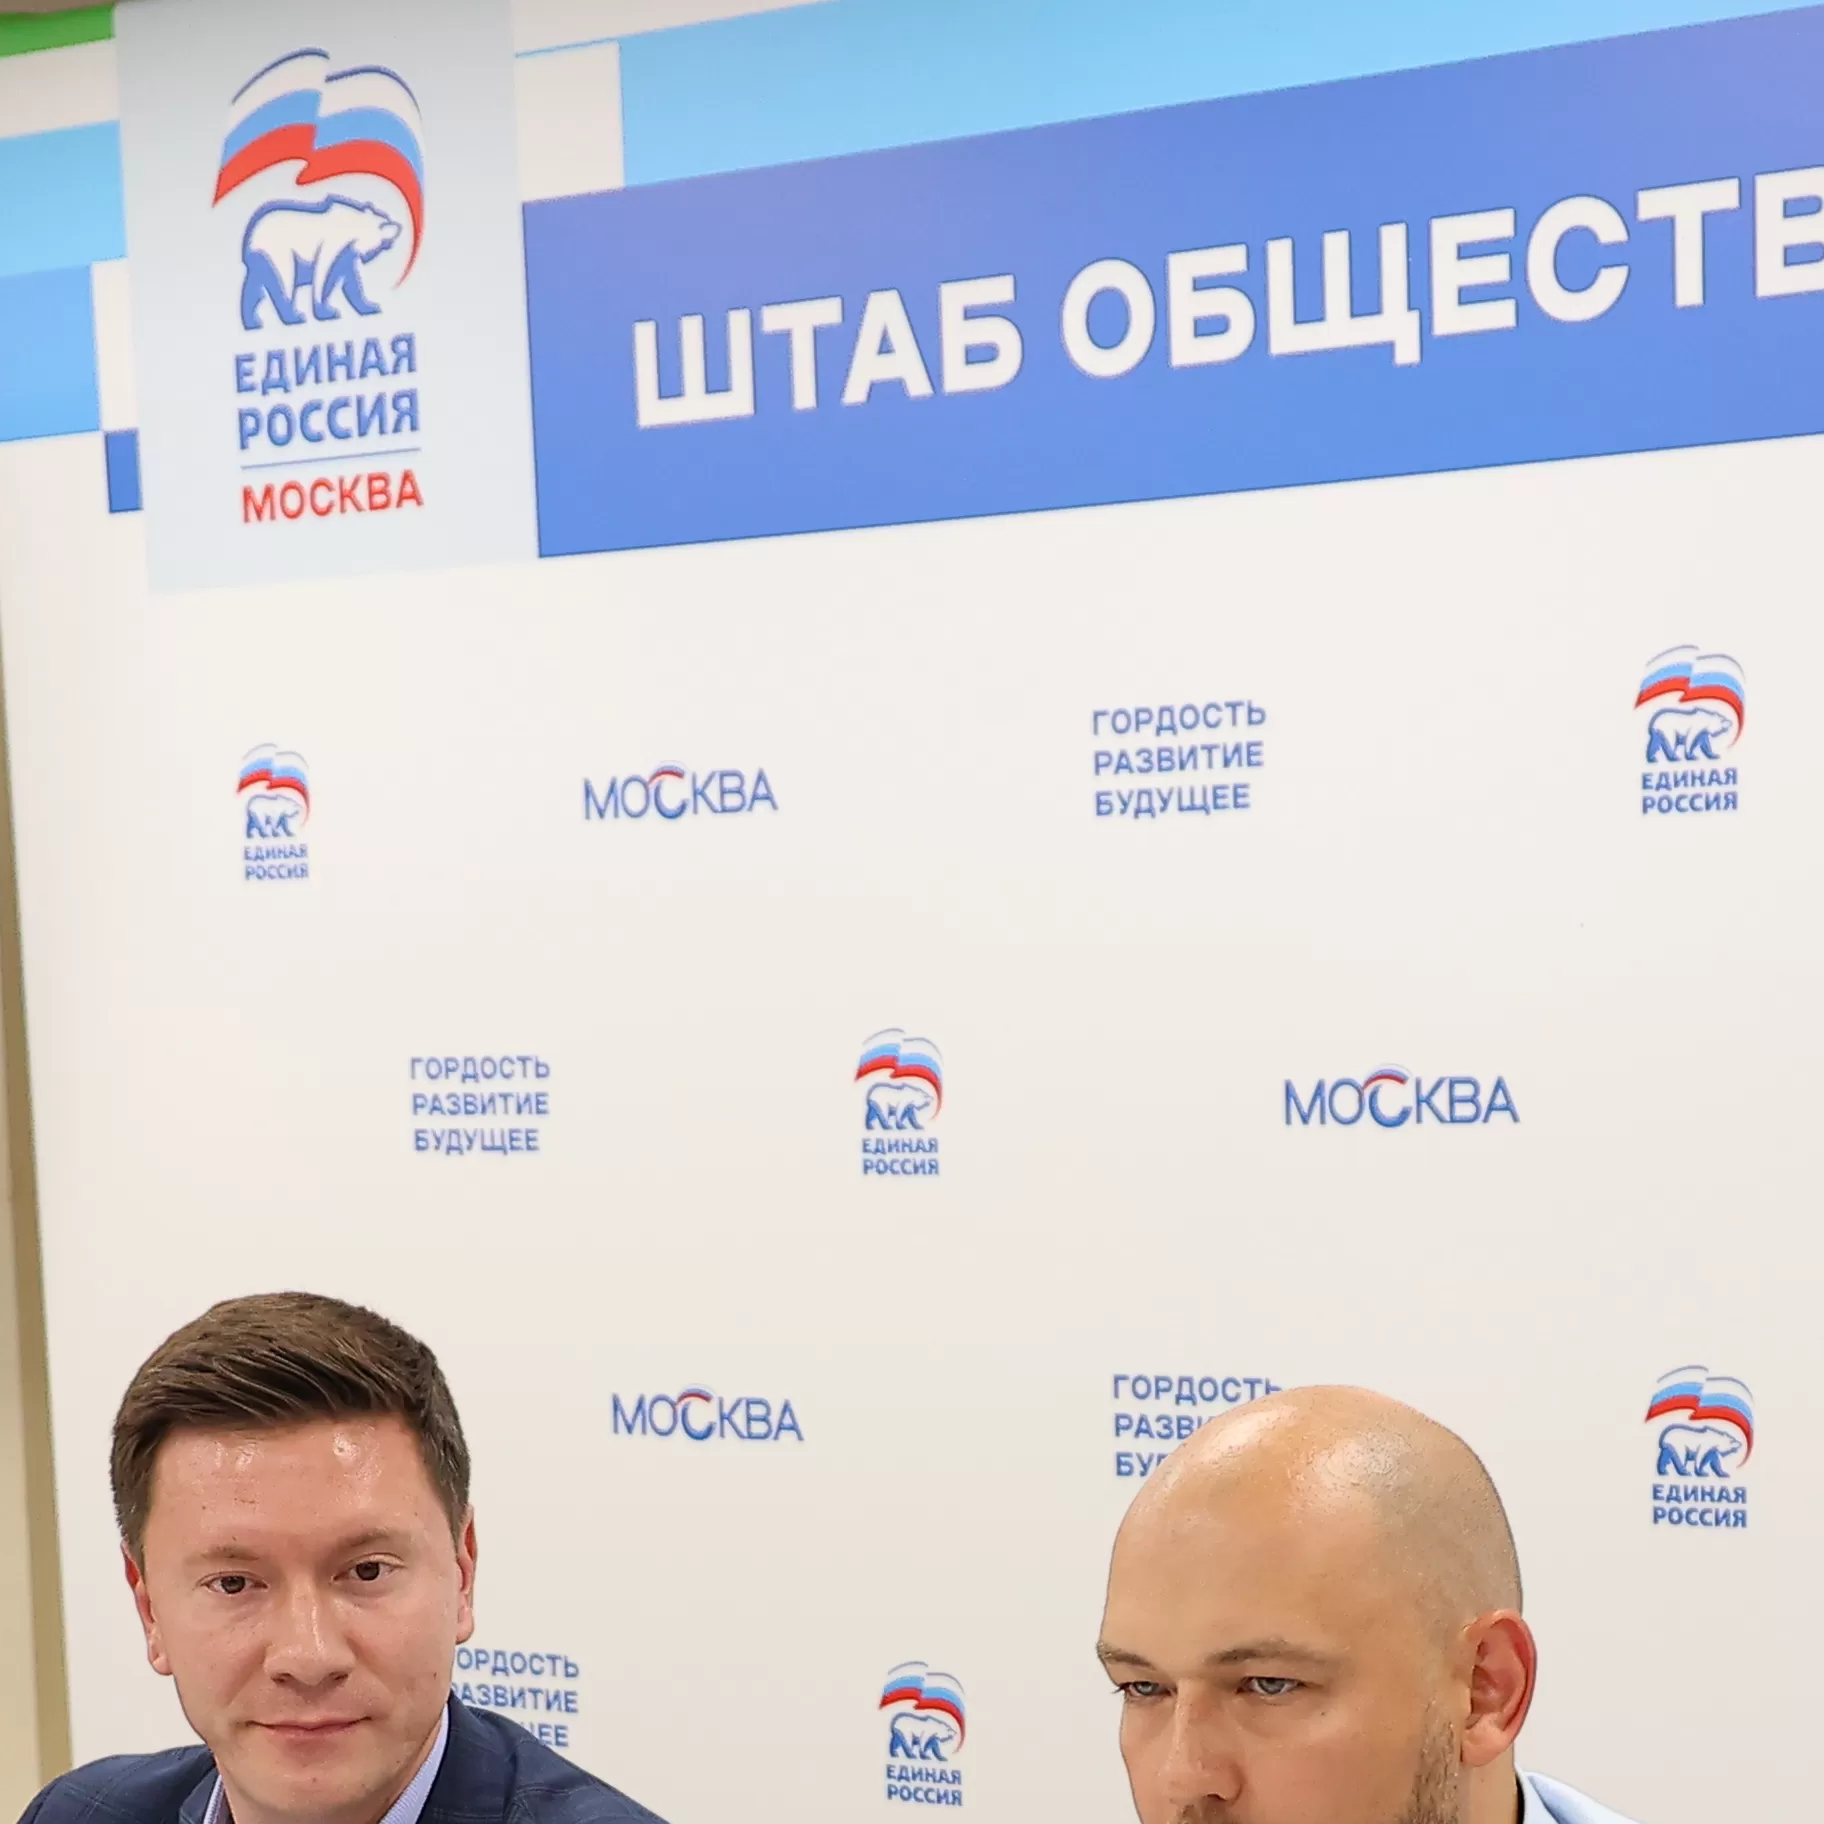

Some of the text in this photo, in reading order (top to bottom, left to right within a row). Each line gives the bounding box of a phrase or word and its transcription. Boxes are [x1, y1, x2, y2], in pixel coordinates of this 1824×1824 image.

[235, 333, 416, 395] ЕДИНАЯ
[631, 277, 1024, 429] ШТАБ
[237, 389, 419, 450] РОССИЯ
[239, 469, 426, 524] МОСКВА
[1092, 700, 1267, 737] ГОРДОСТЬ
[1093, 741, 1264, 777] РАЗВИТИЕ
[583, 762, 778, 821] МОСКВА
[1642, 767, 1738, 793] ЕДИНАЯ
[1095, 783, 1251, 820] БУДУЩЕЕ
[1642, 792, 1738, 815] РОССИЯ
[243, 843, 309, 862] ЕДИНАЯ
[244, 862, 309, 881] РОССИЯ
[410, 1055, 551, 1084] ГОРДОСТЬ
[411, 1091, 550, 1117] РАЗВИТИЕ
[1284, 1064, 1521, 1128] МОСКВА
[413, 1127, 540, 1156] БУДУЩЕЕ
[861, 1137, 939, 1156] ЕДИНАЯ
[862, 1157, 940, 1176] РОССИЯ
[612, 1384, 805, 1443] МОСКВА
[1652, 1483, 1747, 1506] ЕДИНАЯ
[1652, 1506, 1748, 1528] РОССИЯ
[456, 1646, 580, 1679] ОРДОСТЬ
[885, 1763, 962, 1785] ЕДИНАЯ
[886, 1784, 963, 1806] РОССИЯ
